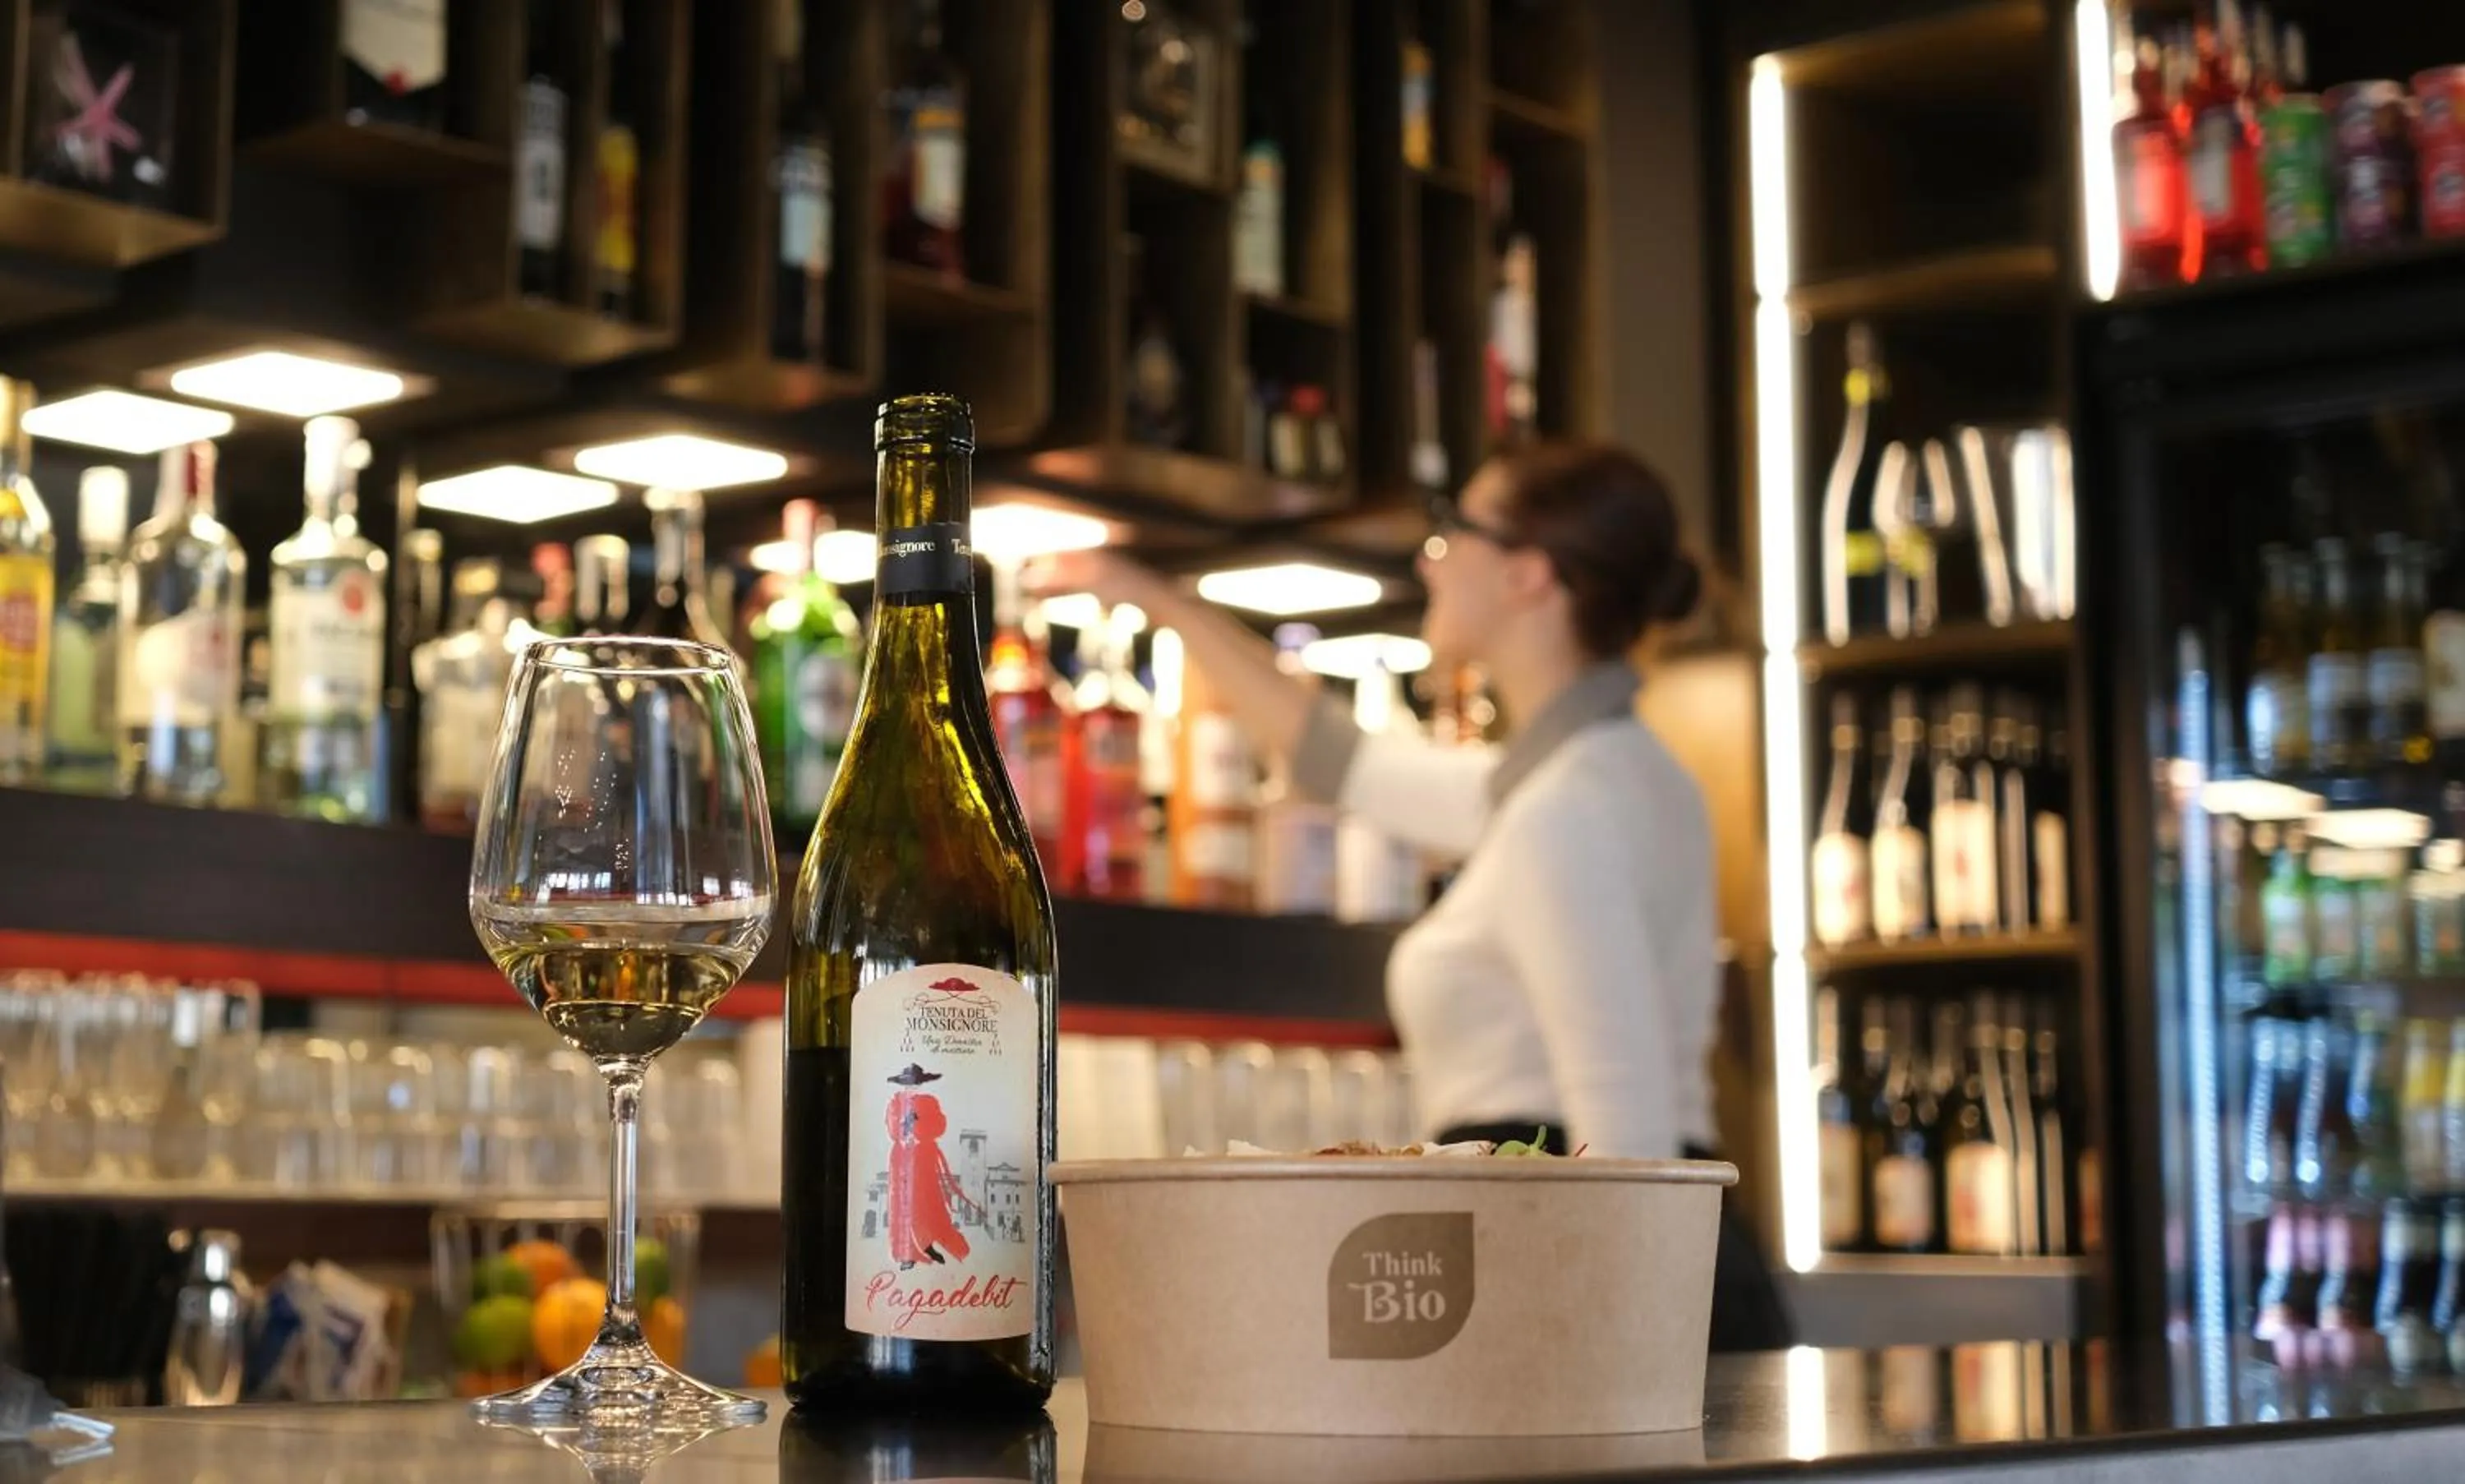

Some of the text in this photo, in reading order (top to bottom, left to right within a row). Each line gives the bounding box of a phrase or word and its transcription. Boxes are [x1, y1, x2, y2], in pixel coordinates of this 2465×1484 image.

[906, 1016, 998, 1033] MONSIGNORE
[919, 1006, 988, 1020] TENUTA DEL
[1362, 1251, 1443, 1277] Think
[865, 1270, 1028, 1330] Pagadebit
[1346, 1279, 1447, 1324] Bio
